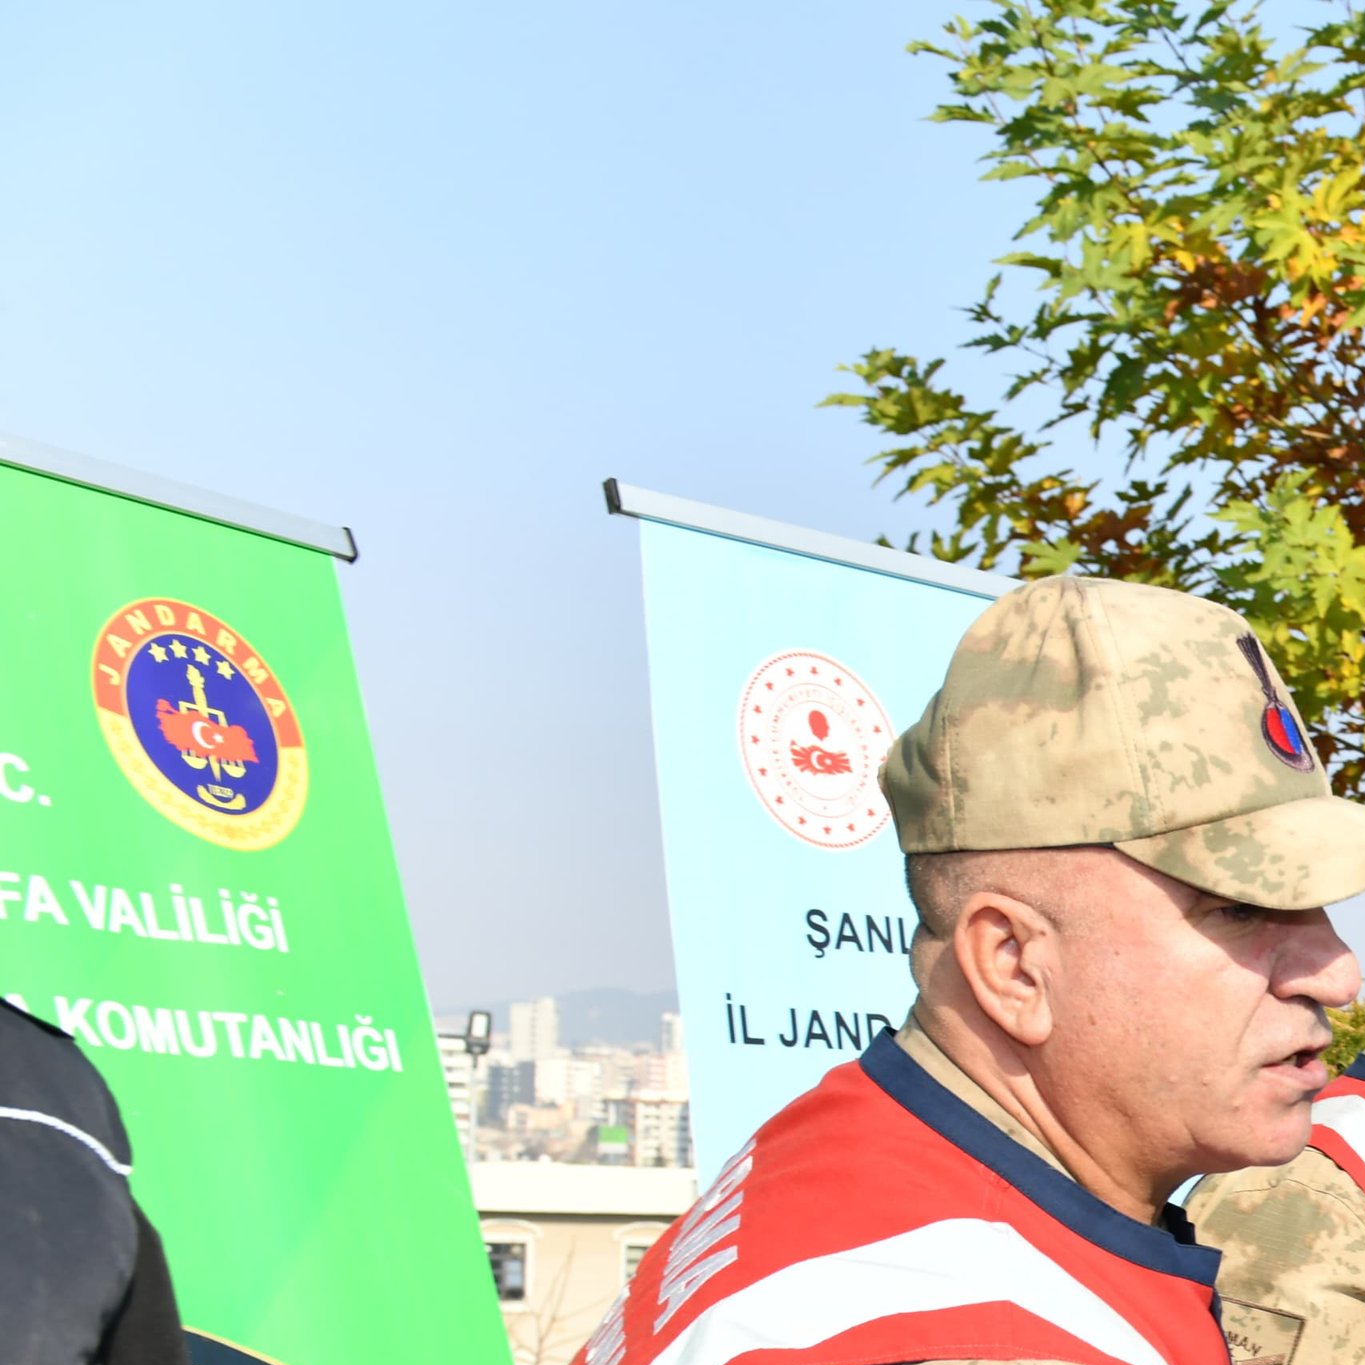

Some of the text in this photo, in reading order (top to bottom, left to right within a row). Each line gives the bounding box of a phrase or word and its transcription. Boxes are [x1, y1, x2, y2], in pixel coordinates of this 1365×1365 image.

[98, 604, 286, 718] JANDARMA
[69, 879, 290, 953] VALİLİĞİ
[54, 995, 404, 1072] KOMUTANLIĞI
[726, 993, 766, 1046] İL
